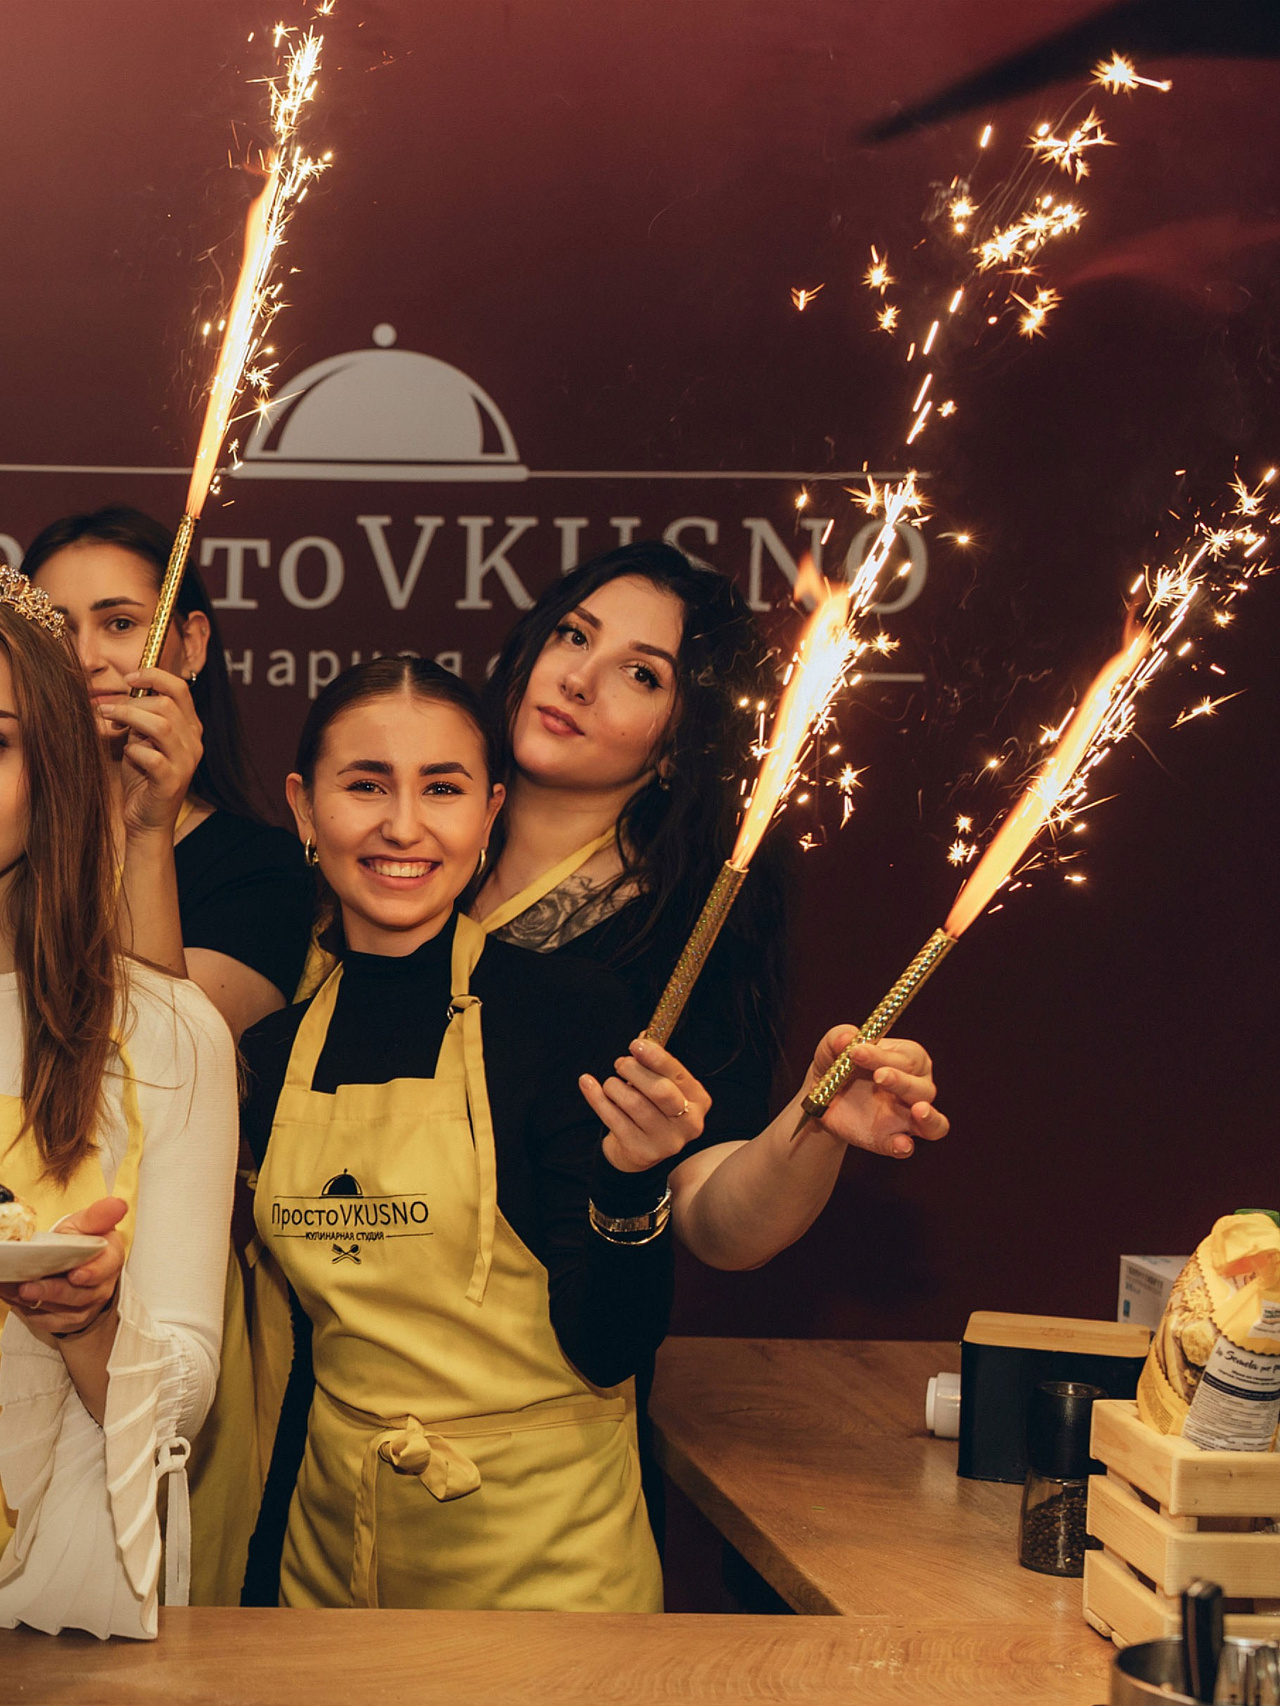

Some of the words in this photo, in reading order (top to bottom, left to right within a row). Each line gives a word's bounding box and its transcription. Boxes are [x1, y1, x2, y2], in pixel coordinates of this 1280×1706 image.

[271, 1201, 429, 1230] ПростоVKUSNO
[305, 1231, 354, 1241] КУЛИНАРНАЯ
[356, 1231, 385, 1241] СТУДИЯ
